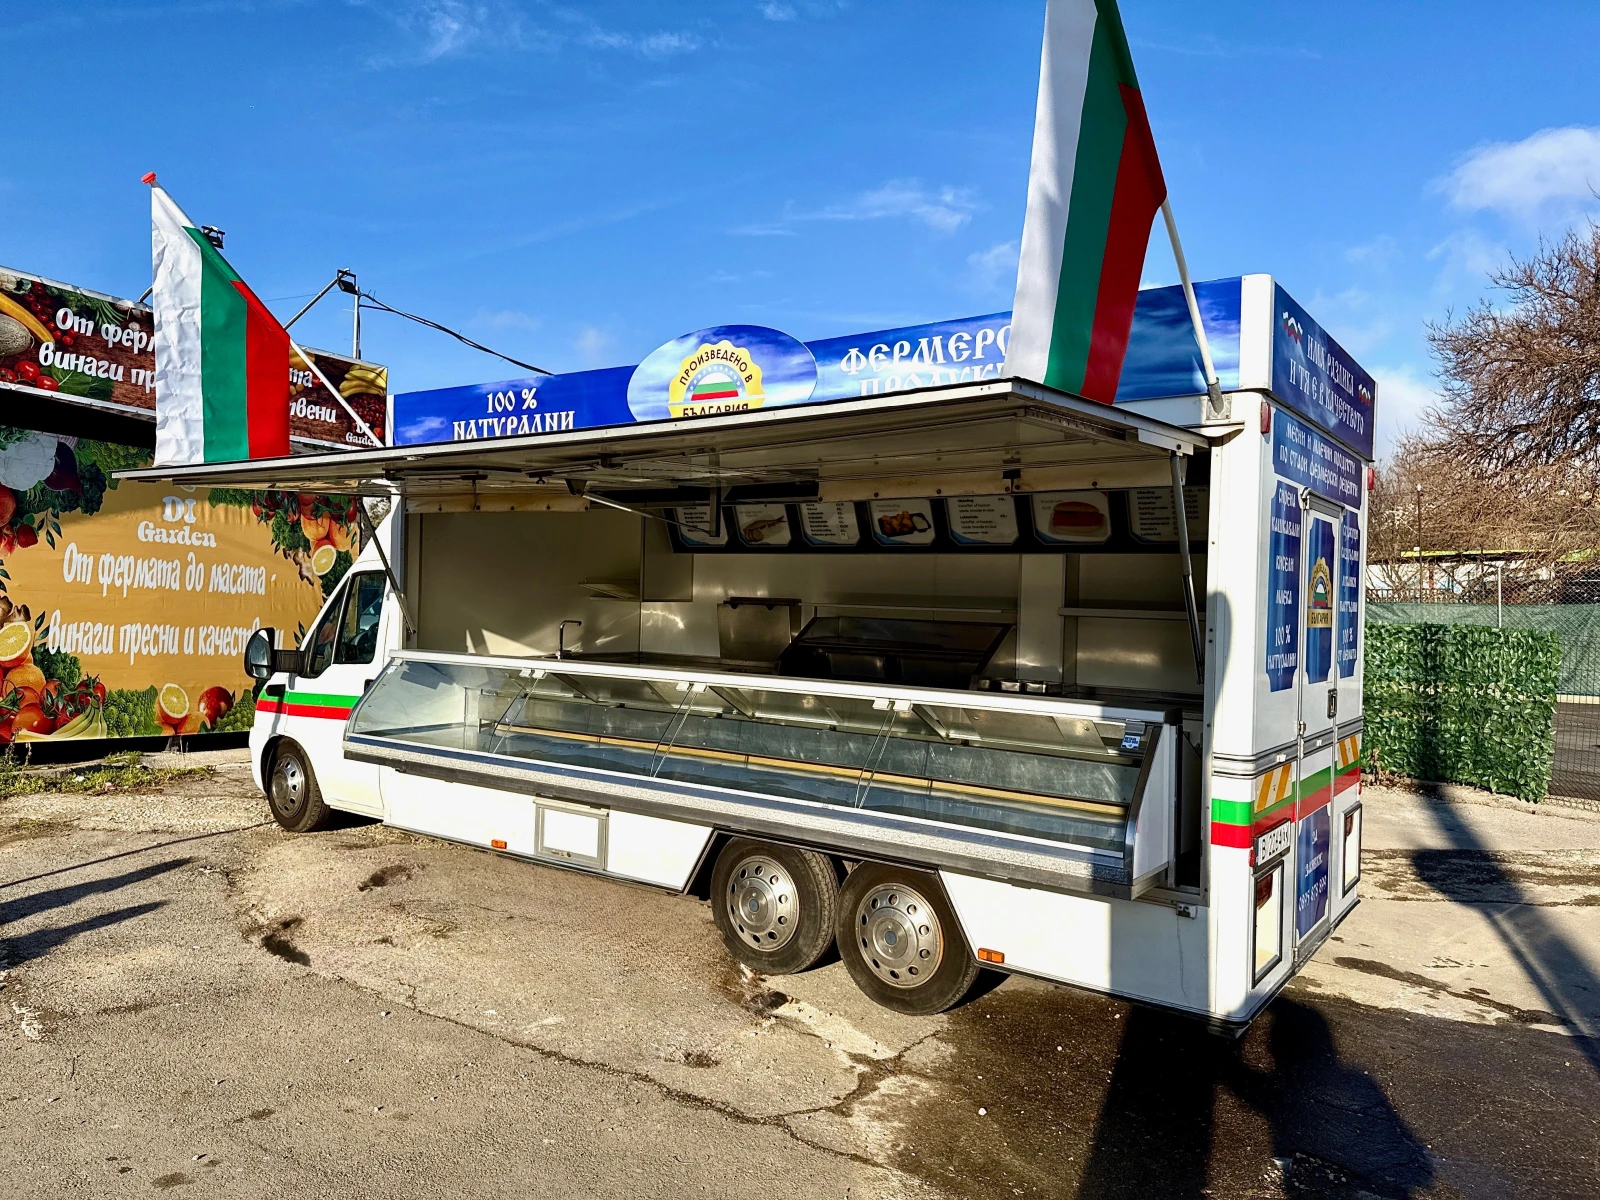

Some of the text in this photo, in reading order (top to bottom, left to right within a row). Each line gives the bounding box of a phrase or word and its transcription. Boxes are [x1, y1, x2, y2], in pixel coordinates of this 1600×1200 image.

[56, 308, 94, 336] От
[39, 341, 124, 381] винаги
[679, 349, 748, 385] ПРОИЗВЕДЕНО
[1326, 353, 1354, 397] РАЗЛИКА
[487, 387, 538, 413] 100 %
[1289, 358, 1296, 385] И
[1299, 366, 1310, 396] ТЯ
[1325, 386, 1364, 435] КАЧЕСТВОТО
[453, 410, 575, 440] НАТУРАЛНИ
[162, 496, 197, 523] DI
[137, 520, 217, 548] Garden
[63, 542, 93, 585] От
[98, 553, 180, 598] фермата
[186, 551, 205, 592] до
[208, 563, 266, 595] масата
[48, 609, 114, 655] винаги
[120, 622, 180, 666] пресни
[184, 627, 195, 655] и
[1275, 626, 1284, 647] 100
